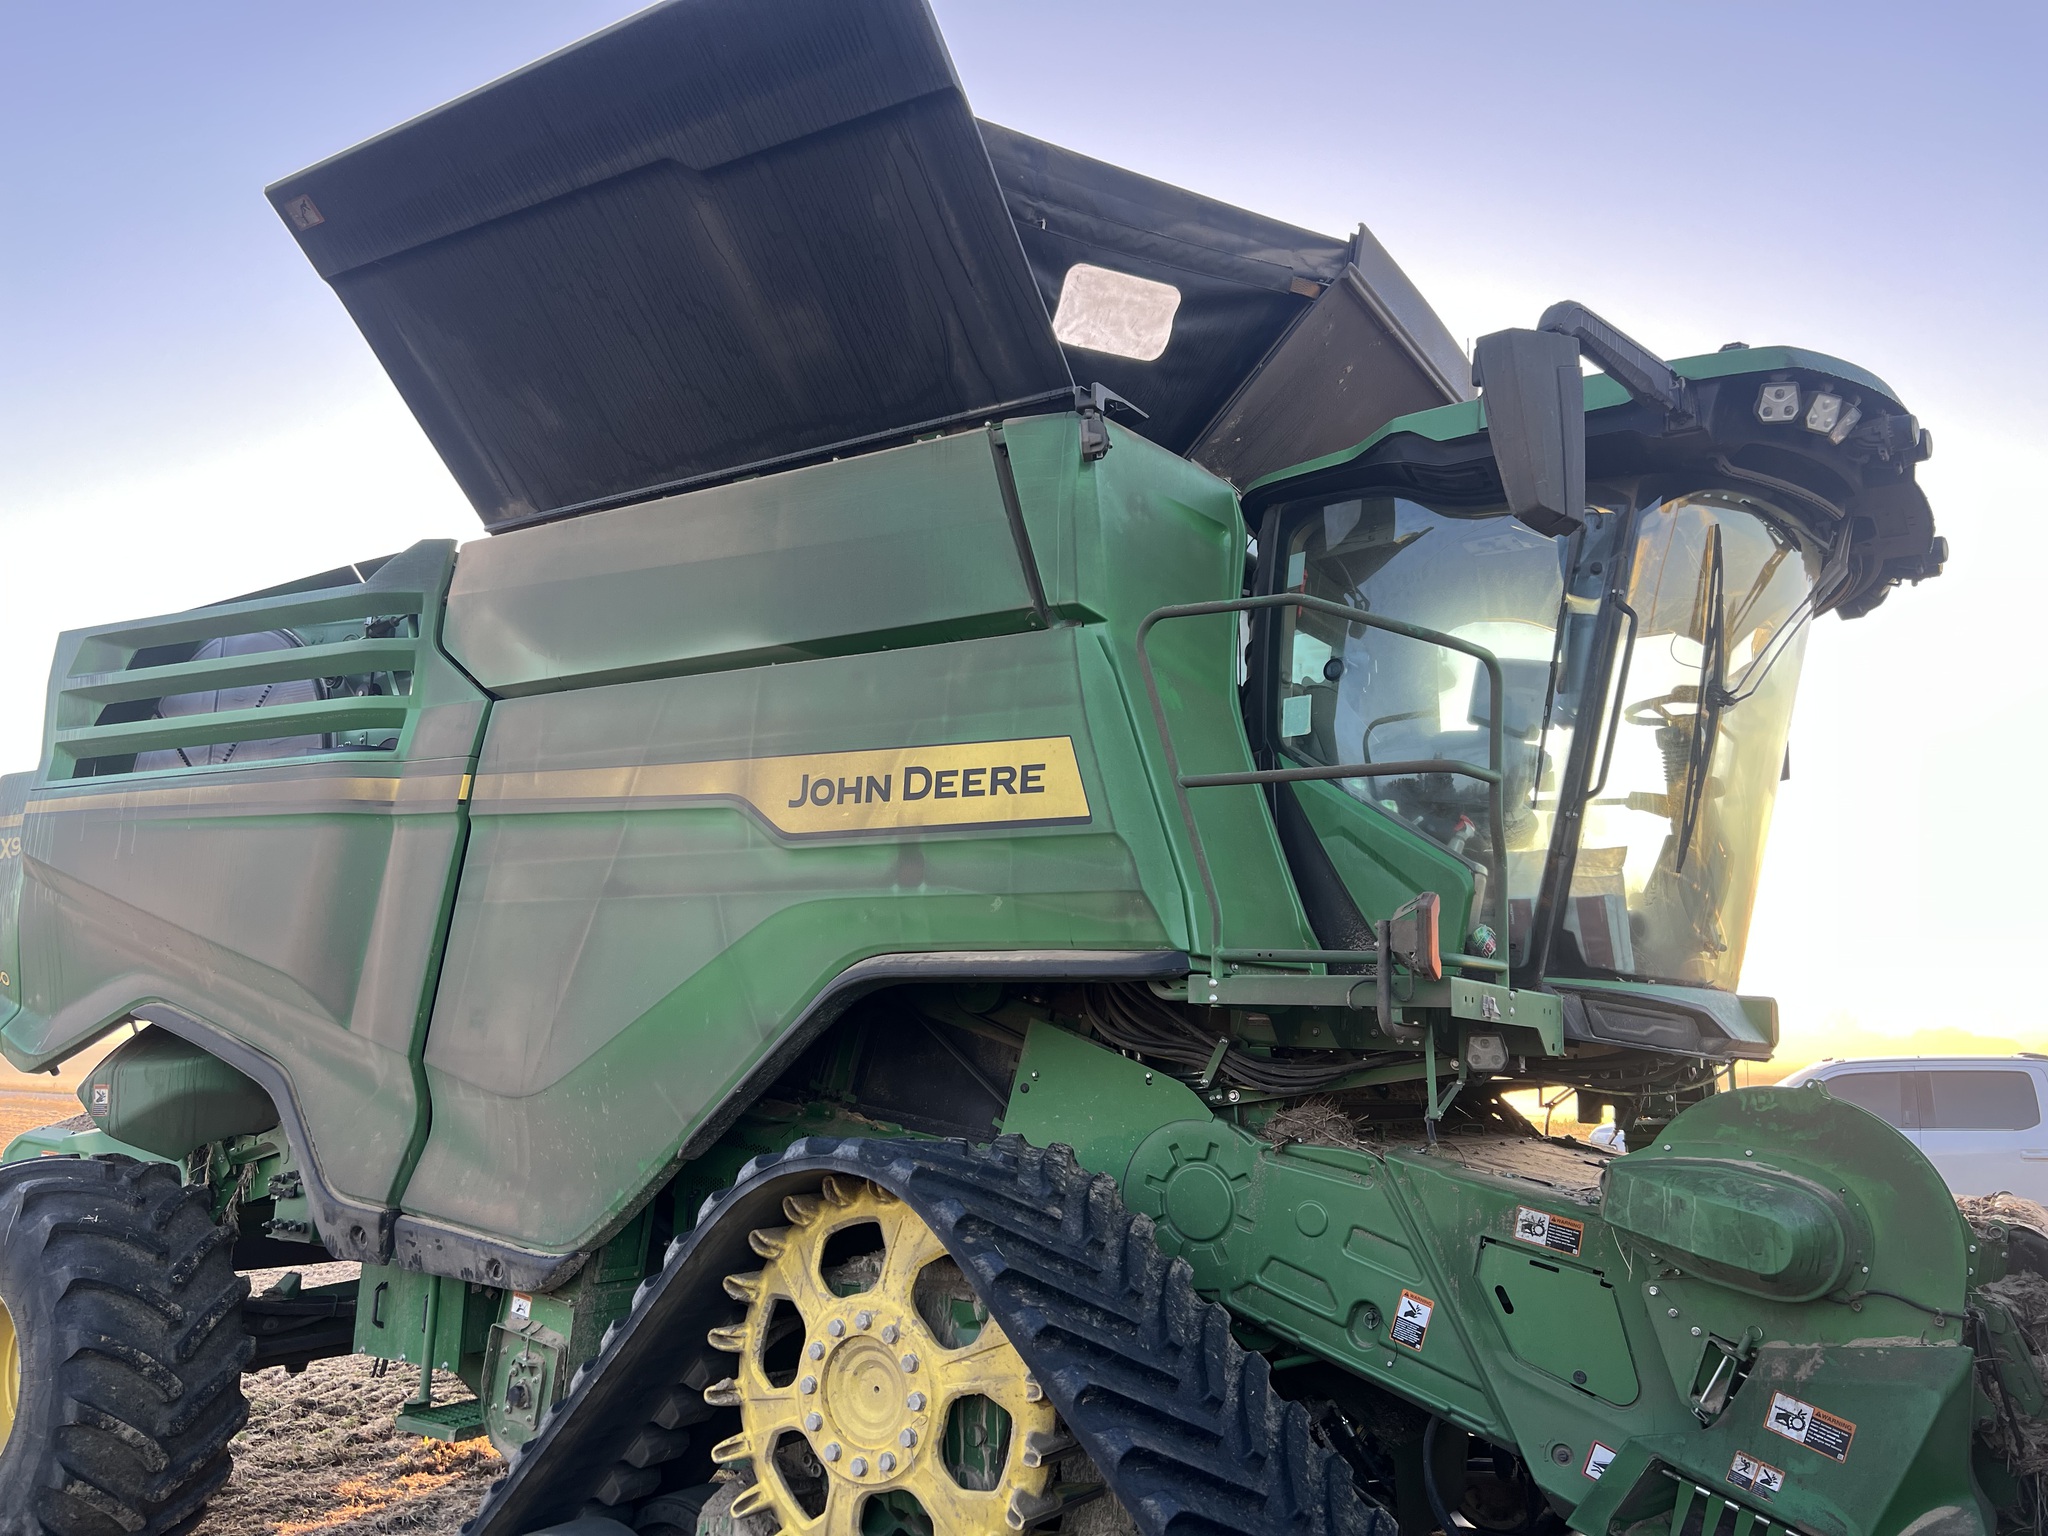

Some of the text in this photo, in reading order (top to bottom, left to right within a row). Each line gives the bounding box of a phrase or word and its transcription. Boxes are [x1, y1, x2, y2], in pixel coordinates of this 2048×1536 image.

[788, 764, 1046, 808] JOHN DEERE
[0, 836, 21, 859] X9
[1822, 1413, 1852, 1431] WARNING
